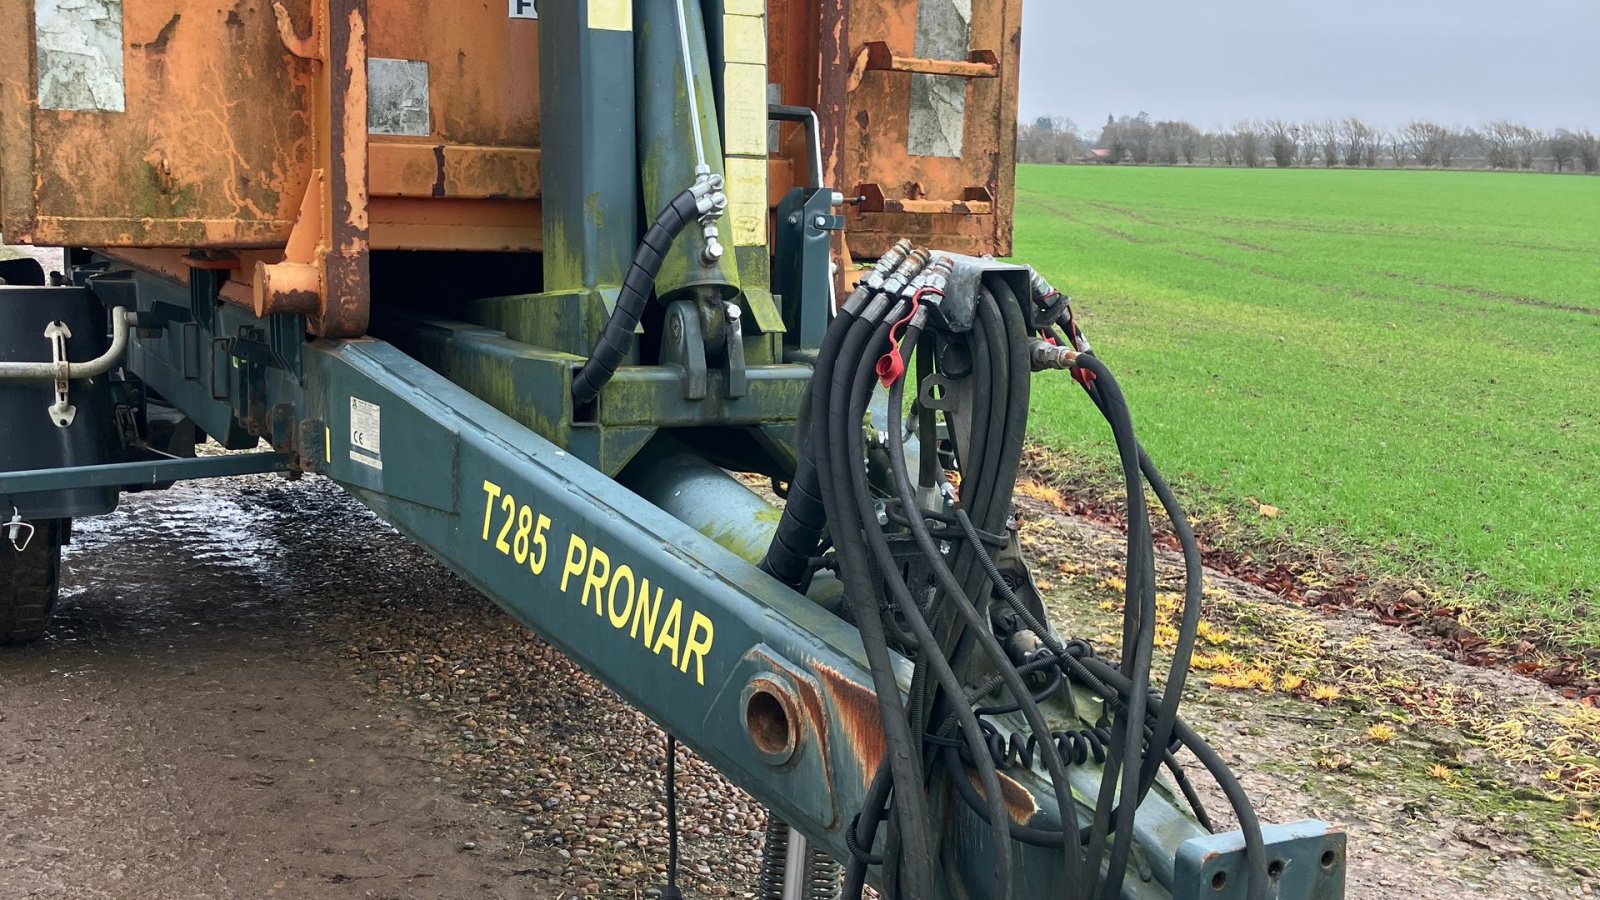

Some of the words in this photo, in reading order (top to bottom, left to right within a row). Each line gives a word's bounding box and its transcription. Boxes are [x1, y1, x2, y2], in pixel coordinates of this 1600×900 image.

[353, 430, 364, 446] CE
[482, 479, 552, 576] T285
[560, 533, 714, 686] PRONAR
